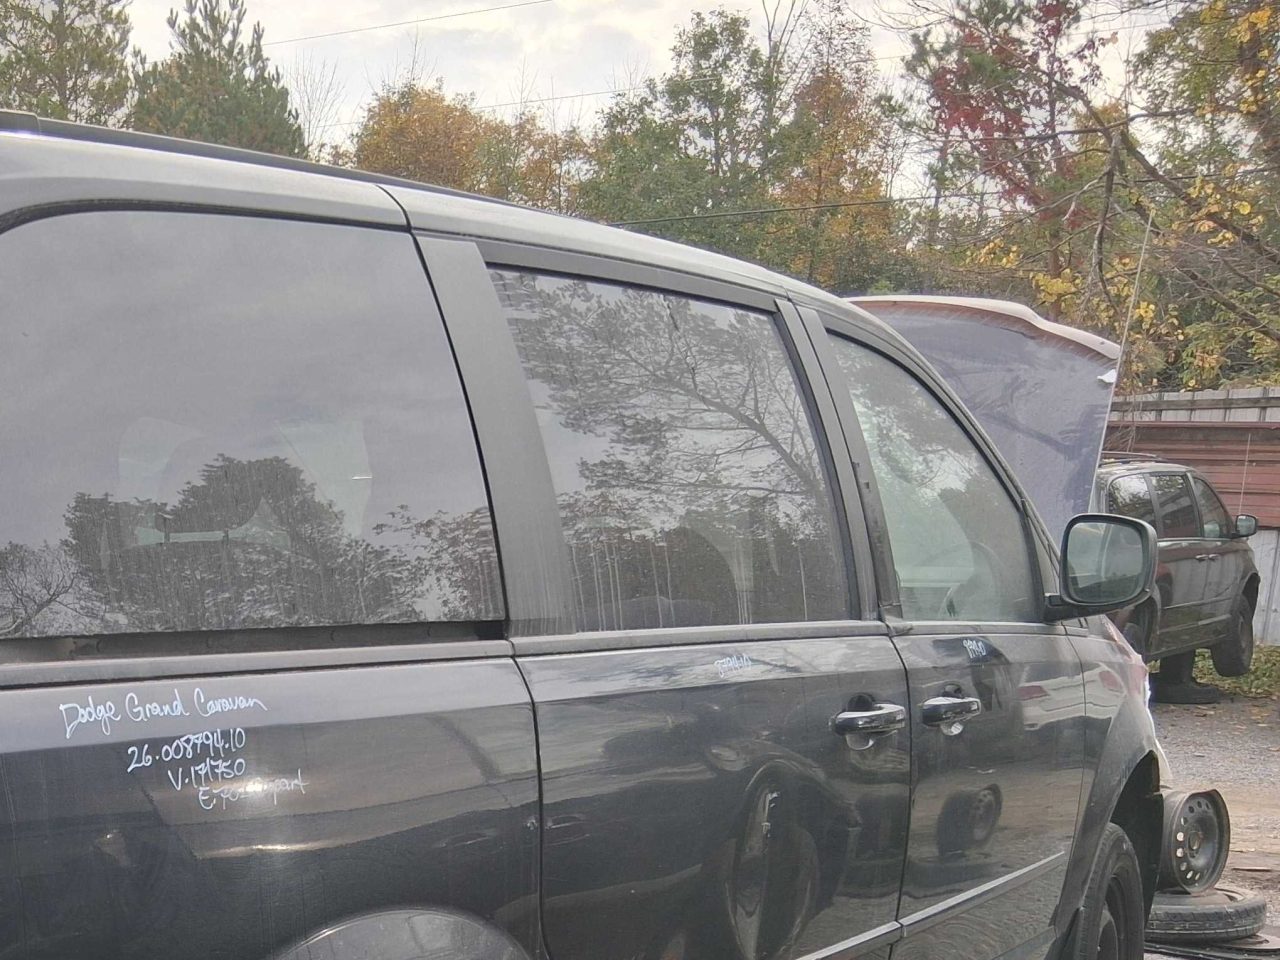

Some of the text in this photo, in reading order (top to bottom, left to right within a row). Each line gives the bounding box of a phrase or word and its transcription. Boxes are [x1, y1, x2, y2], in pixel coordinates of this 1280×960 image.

[59, 687, 268, 739] Dodge Grand Caravan
